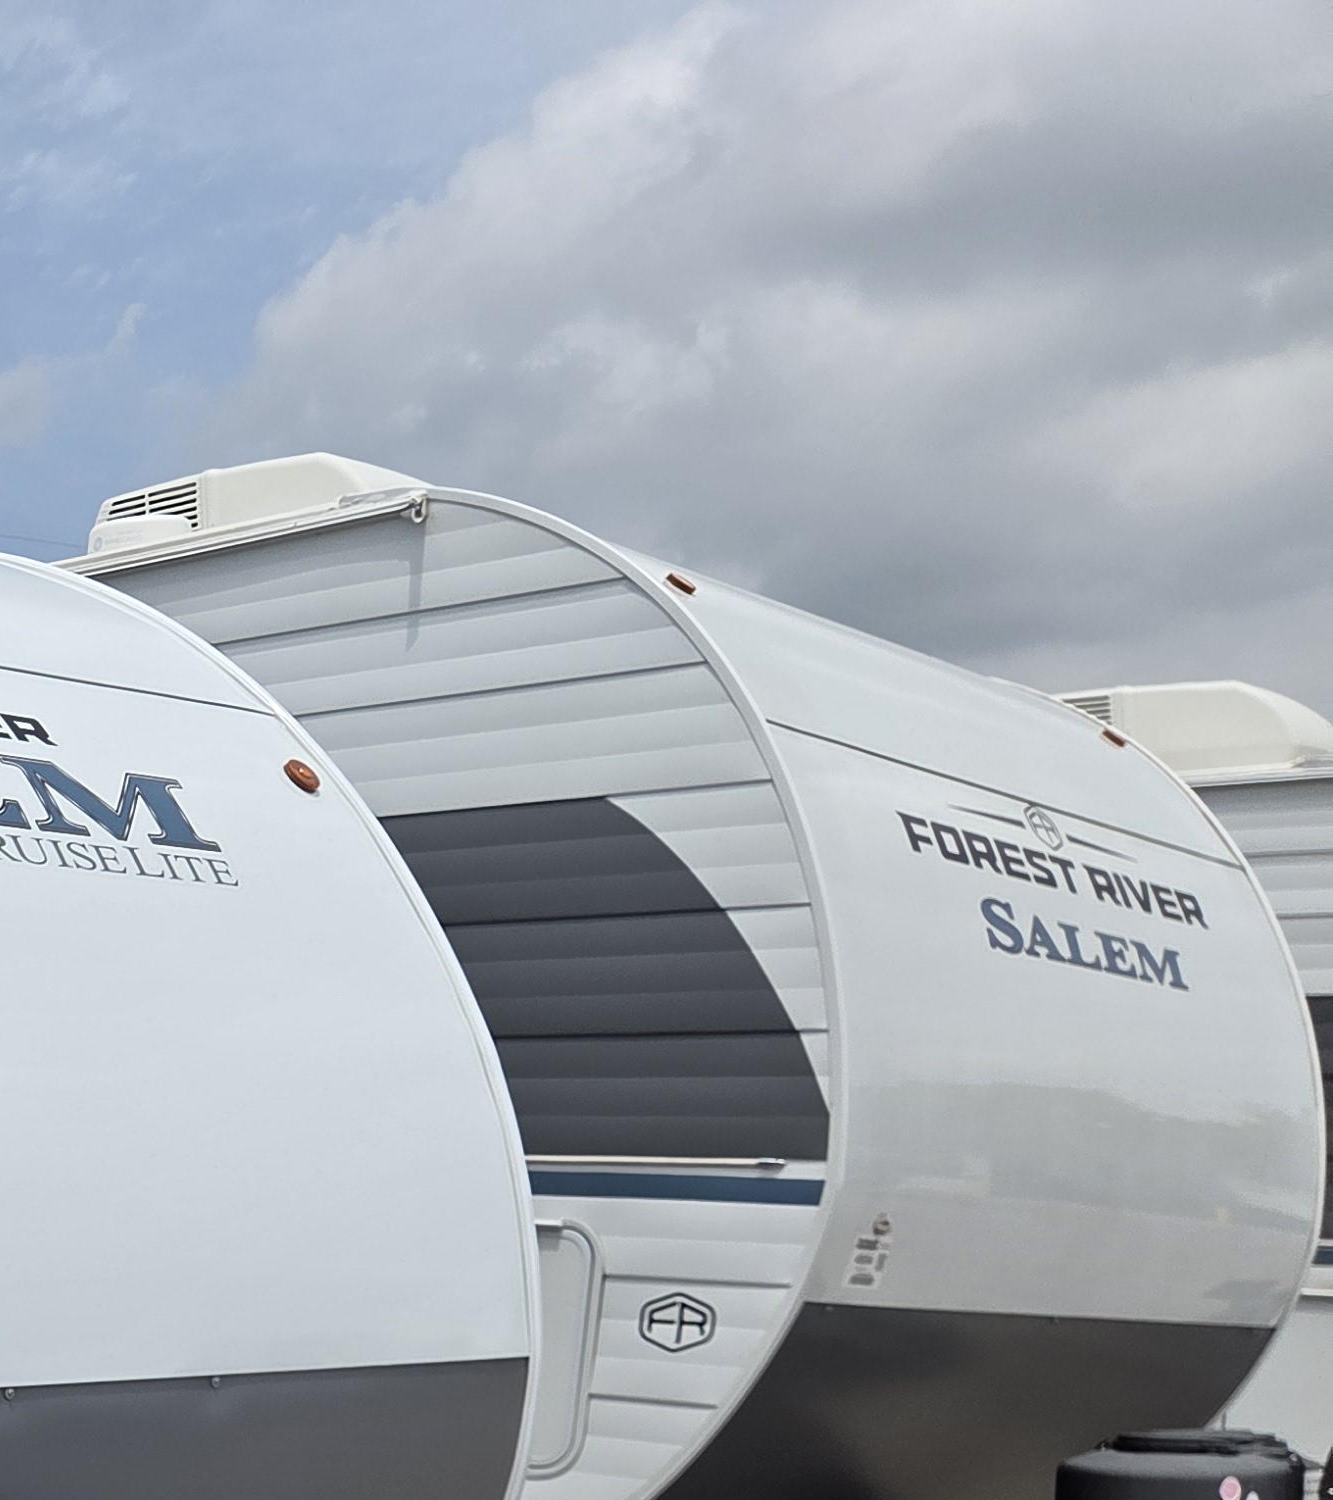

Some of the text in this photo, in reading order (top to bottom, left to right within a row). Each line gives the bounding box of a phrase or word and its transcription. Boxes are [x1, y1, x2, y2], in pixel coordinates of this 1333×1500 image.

[895, 810, 1210, 930] FOREST RIVER
[979, 897, 1190, 991] SALEM
